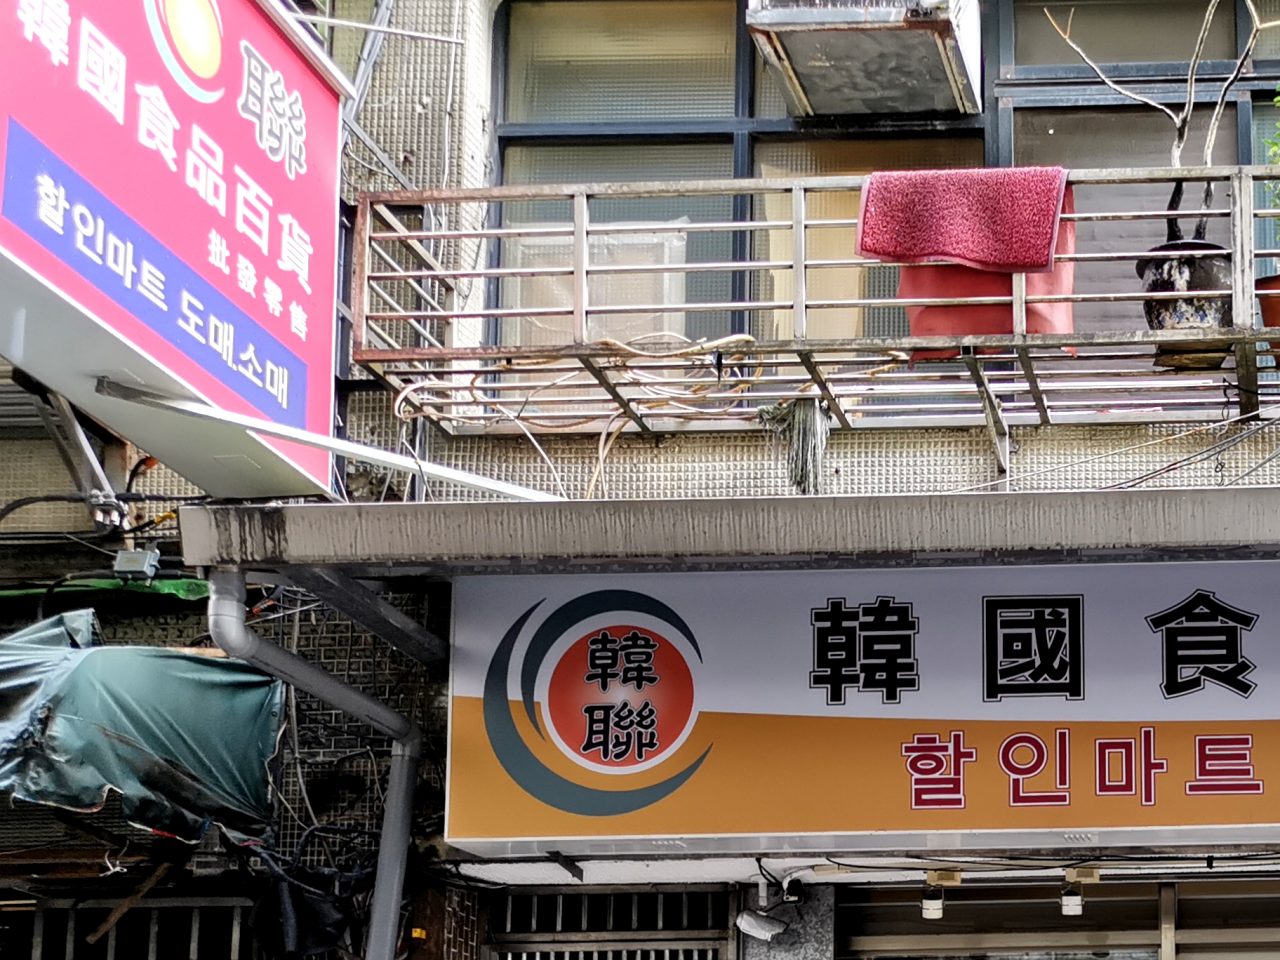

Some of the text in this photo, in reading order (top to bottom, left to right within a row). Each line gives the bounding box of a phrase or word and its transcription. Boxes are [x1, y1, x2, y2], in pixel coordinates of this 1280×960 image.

[237, 38, 308, 181] 聯
[36, 173, 290, 410] 할인마트 도매소매
[207, 228, 310, 342] 批發零售
[580, 629, 661, 763] 韓聯
[901, 727, 1264, 811] 할인마트
